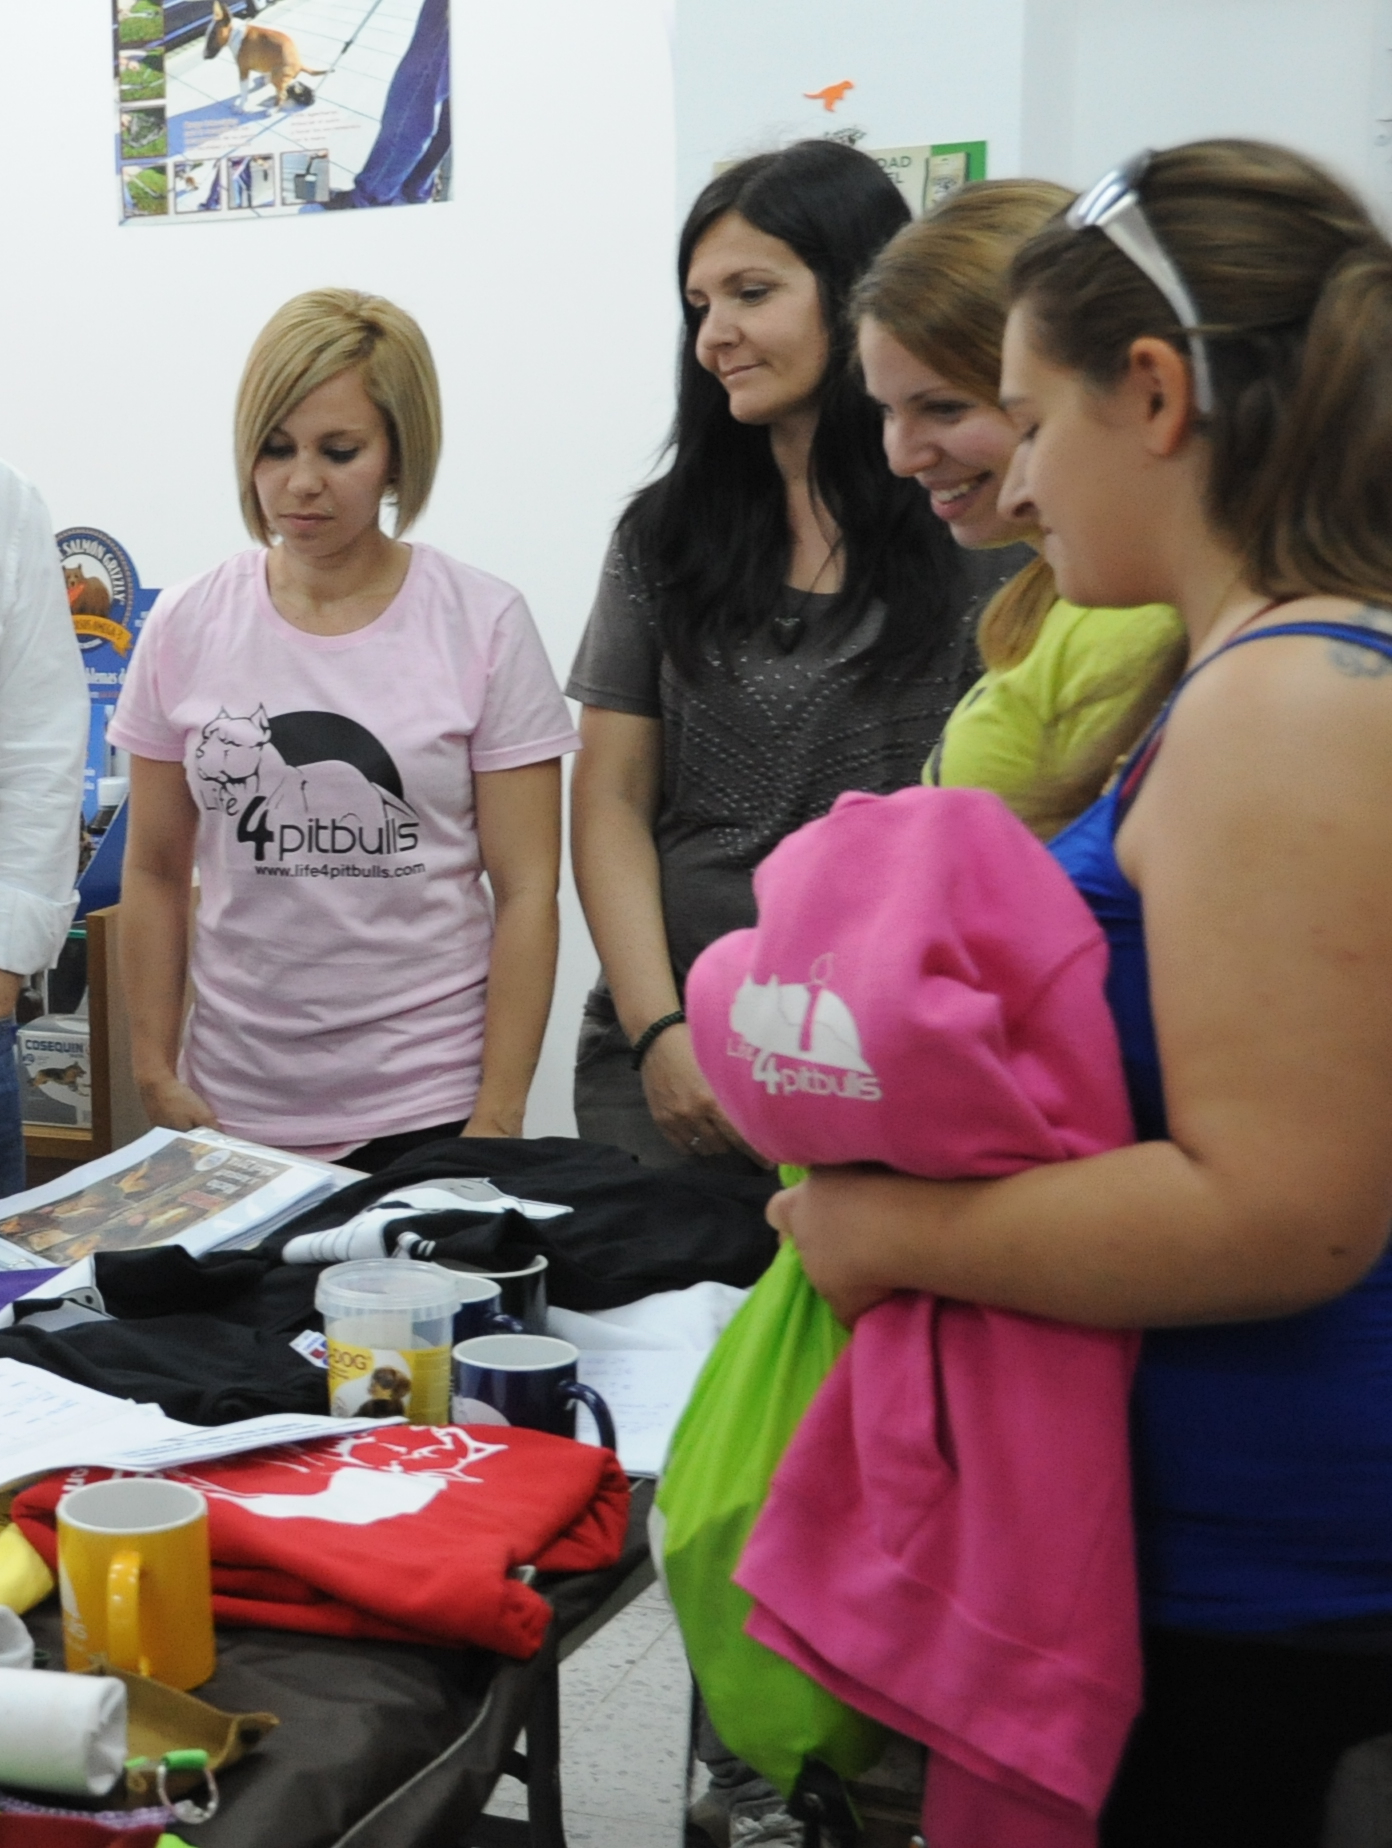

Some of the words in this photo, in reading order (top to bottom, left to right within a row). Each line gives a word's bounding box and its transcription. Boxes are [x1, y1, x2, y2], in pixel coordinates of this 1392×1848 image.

[236, 795, 420, 862] 4pitbulls
[254, 863, 426, 880] www.life4pitbulls.com
[25, 1040, 84, 1053] COSEQUIN
